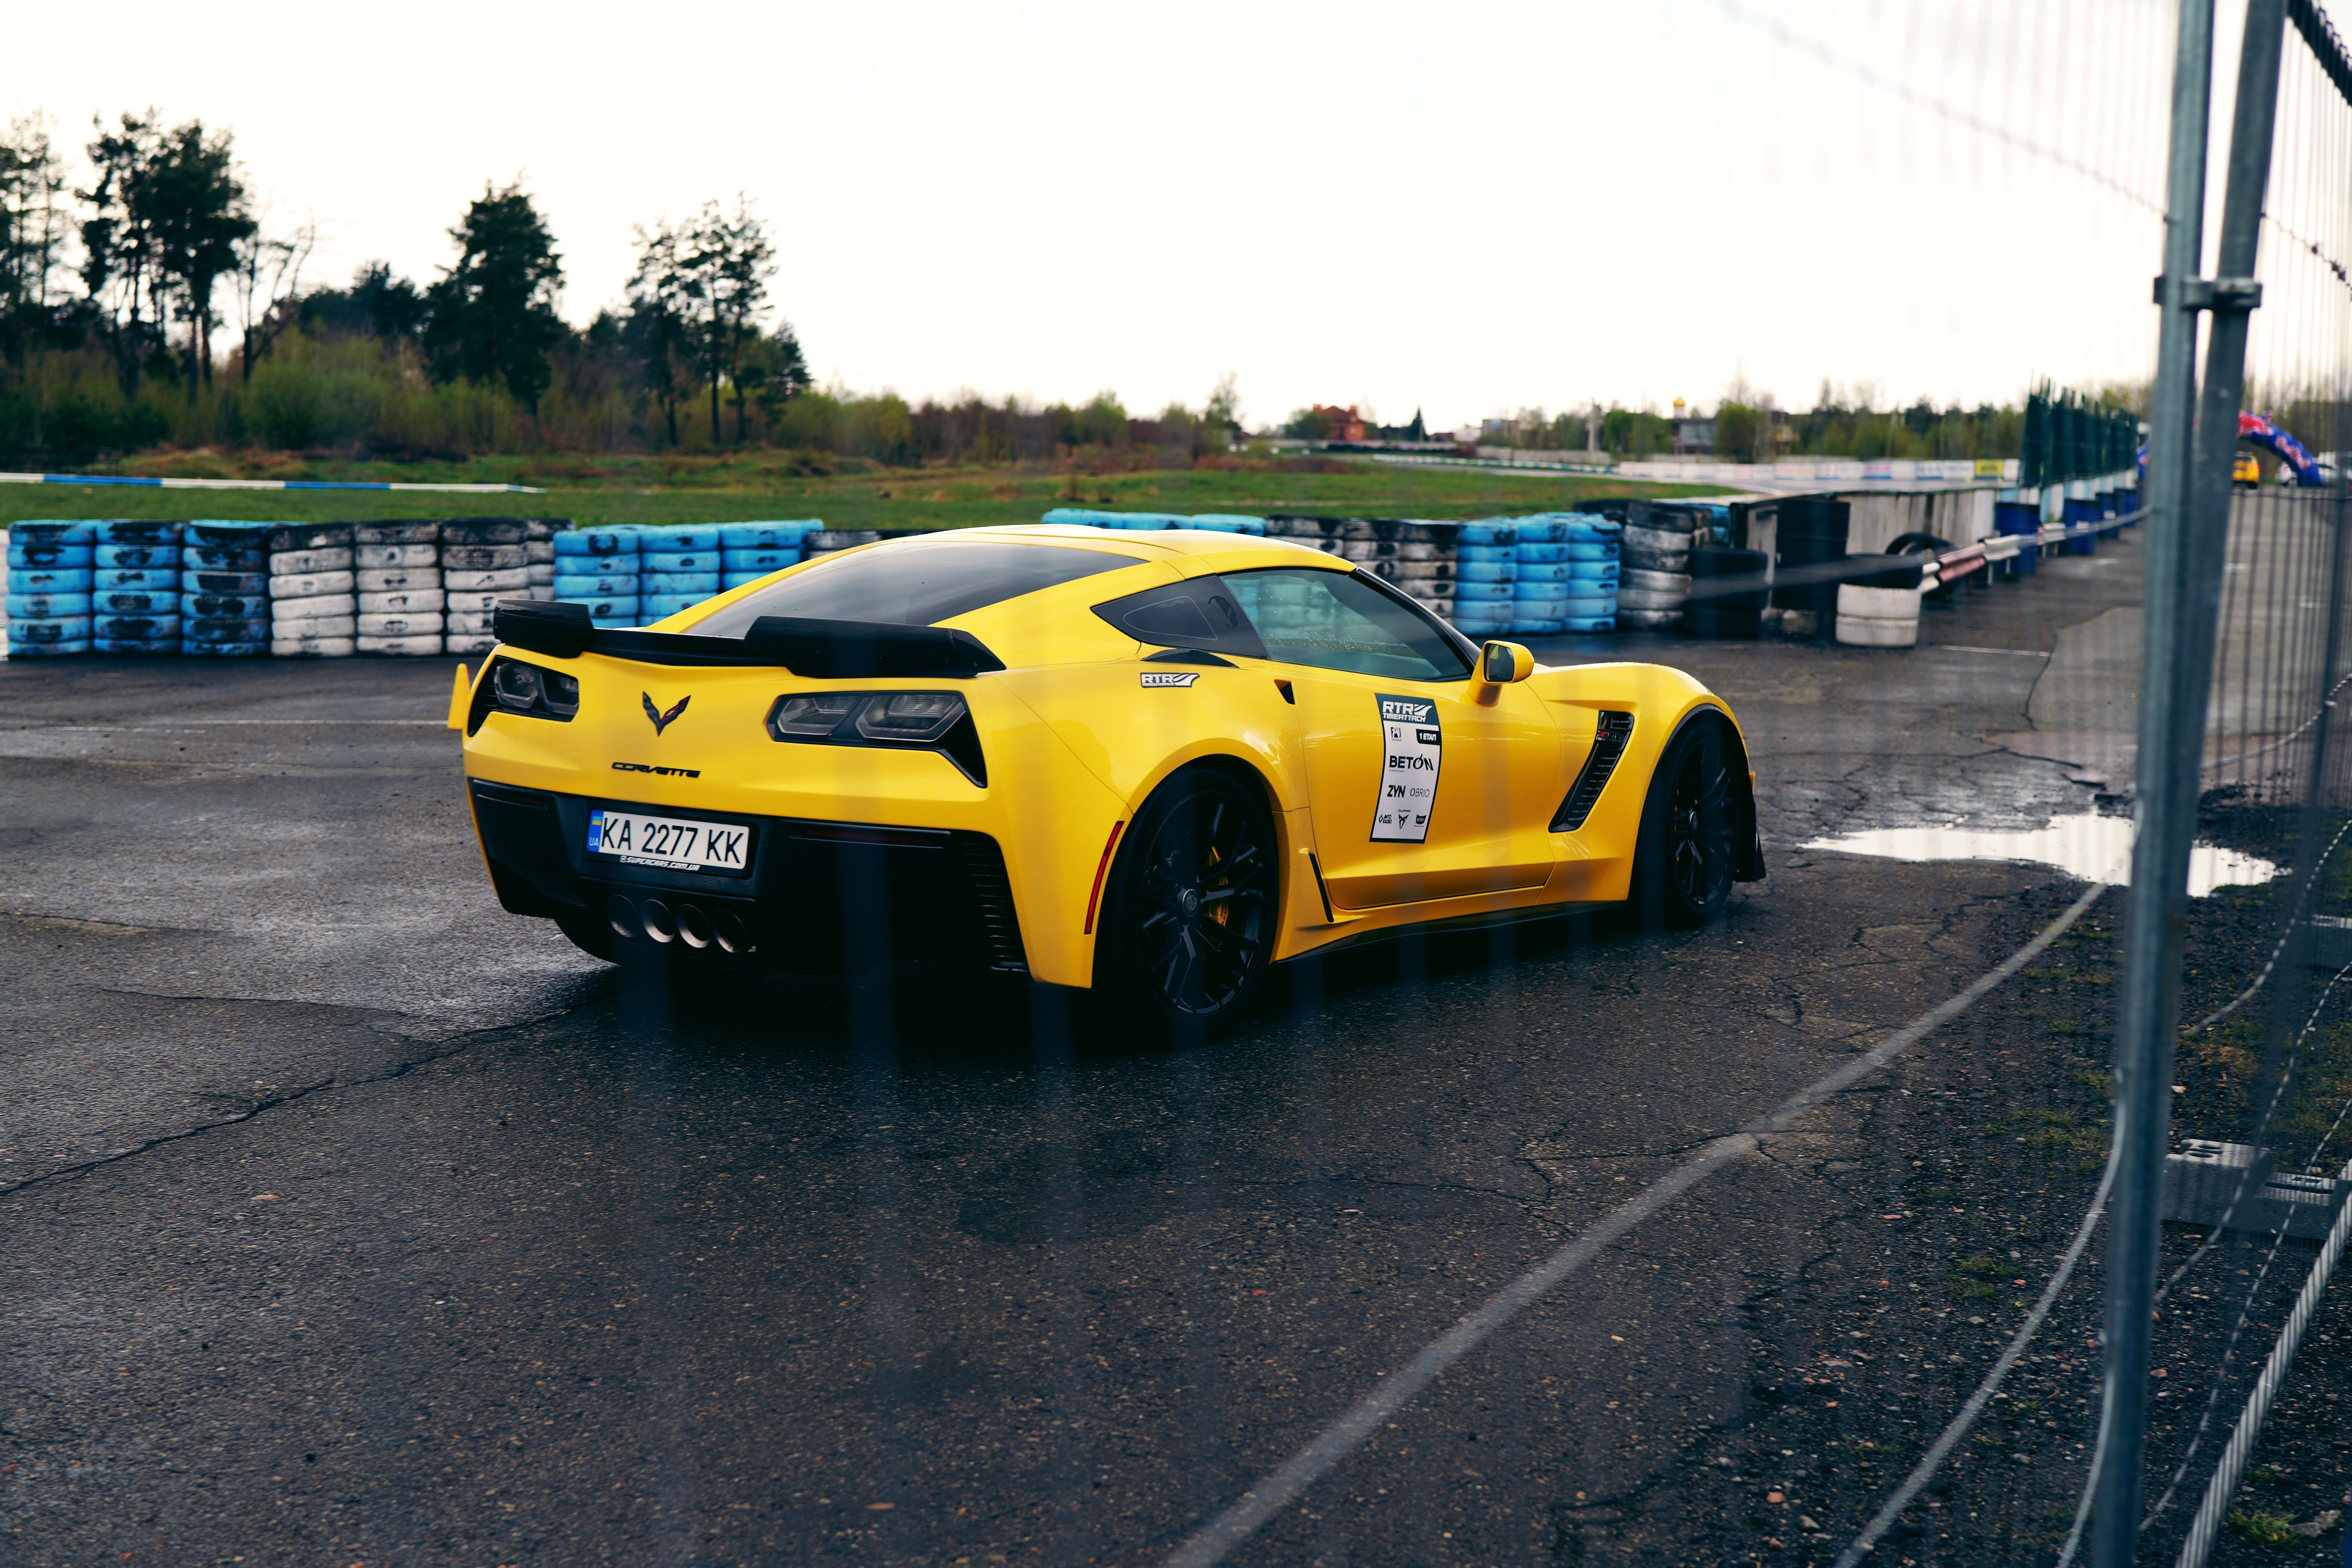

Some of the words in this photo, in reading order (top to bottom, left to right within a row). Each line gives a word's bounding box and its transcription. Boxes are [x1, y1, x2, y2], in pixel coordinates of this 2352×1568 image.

[1141, 674, 1174, 683] RTR
[1383, 701, 1414, 715] RTR
[612, 762, 701, 778] CORVETTE
[1387, 785, 1406, 798] ZYN
[1410, 788, 1430, 798] OBRIO
[589, 837, 599, 847] UA
[601, 817, 632, 850] KA
[641, 823, 698, 857] 2277
[706, 829, 744, 864] KK
